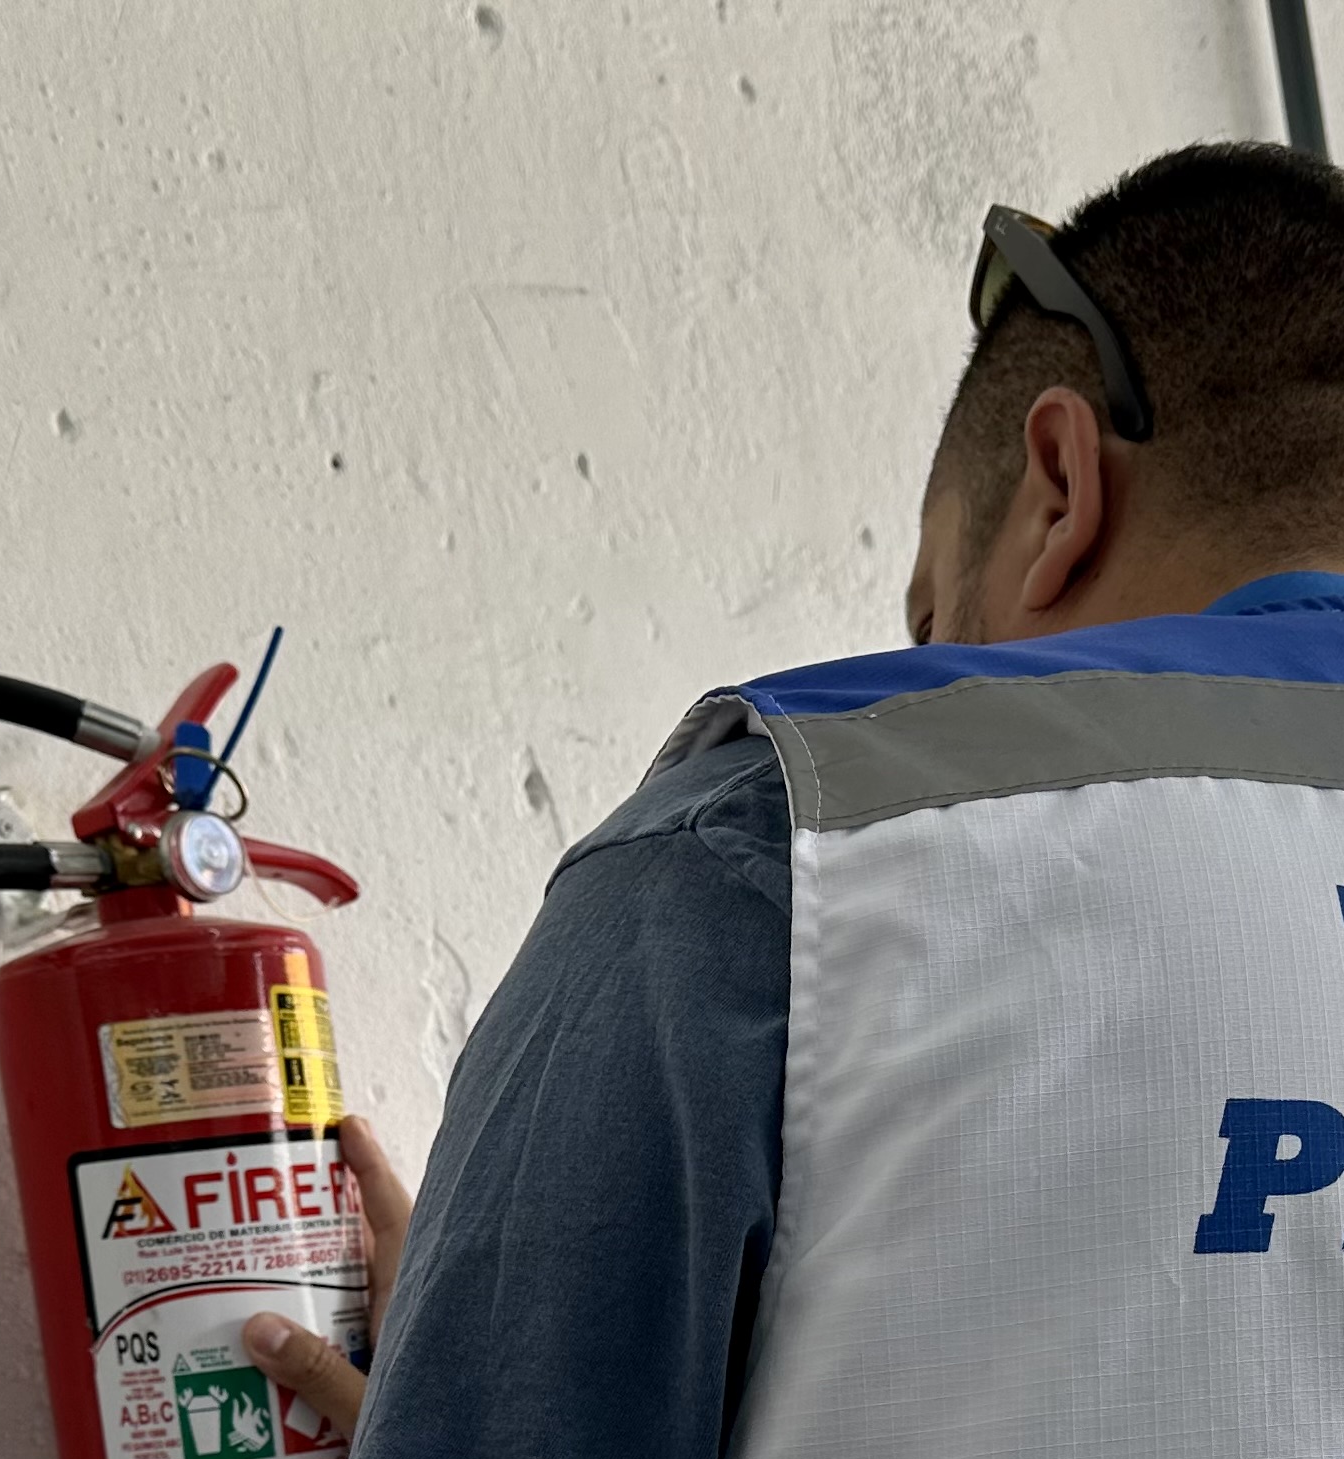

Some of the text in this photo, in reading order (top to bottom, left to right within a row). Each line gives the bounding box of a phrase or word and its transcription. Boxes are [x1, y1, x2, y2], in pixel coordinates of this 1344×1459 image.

[137, 1231, 206, 1248] COMÉRCIO
[209, 1229, 225, 1241] DE
[117, 1331, 160, 1365] PQS
